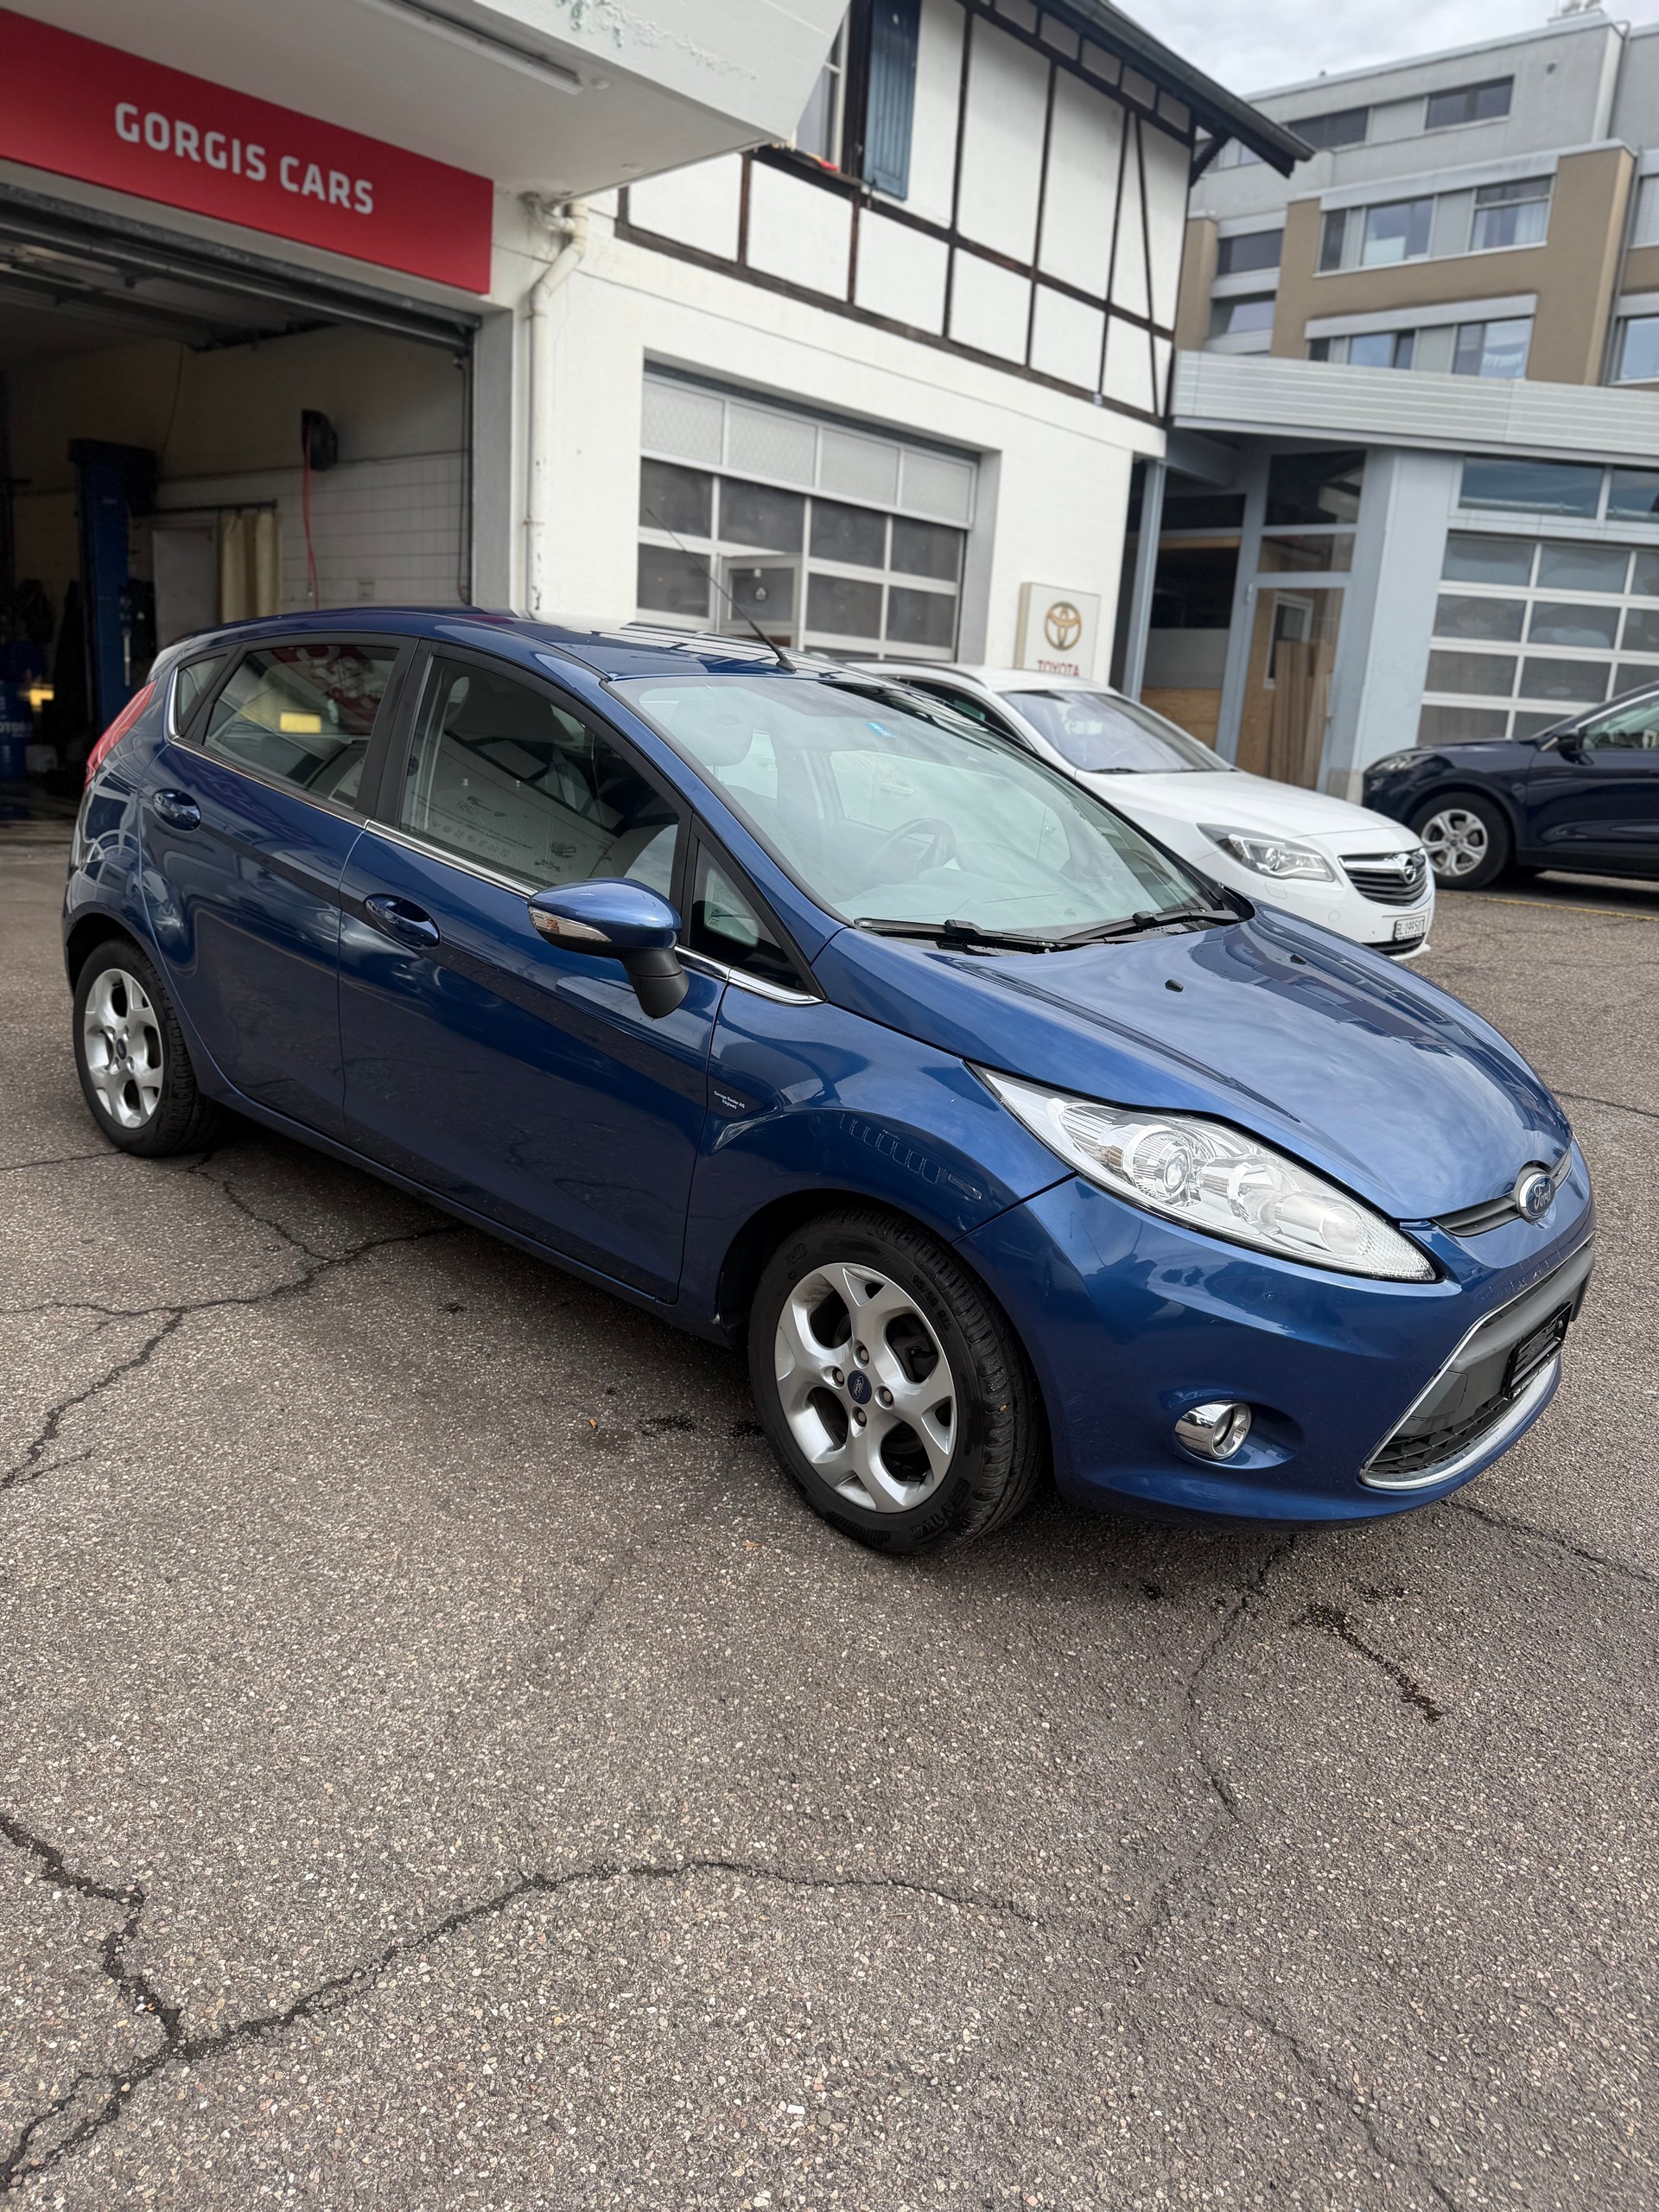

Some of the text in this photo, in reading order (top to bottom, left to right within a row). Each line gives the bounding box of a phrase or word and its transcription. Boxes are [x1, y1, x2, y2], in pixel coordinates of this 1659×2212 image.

[115, 102, 373, 215] GORGIS CARS
[1037, 659, 1079, 677] TOYOTA
[1534, 1180, 1551, 1211] Ford
[908, 1270, 938, 1306] 195/50
